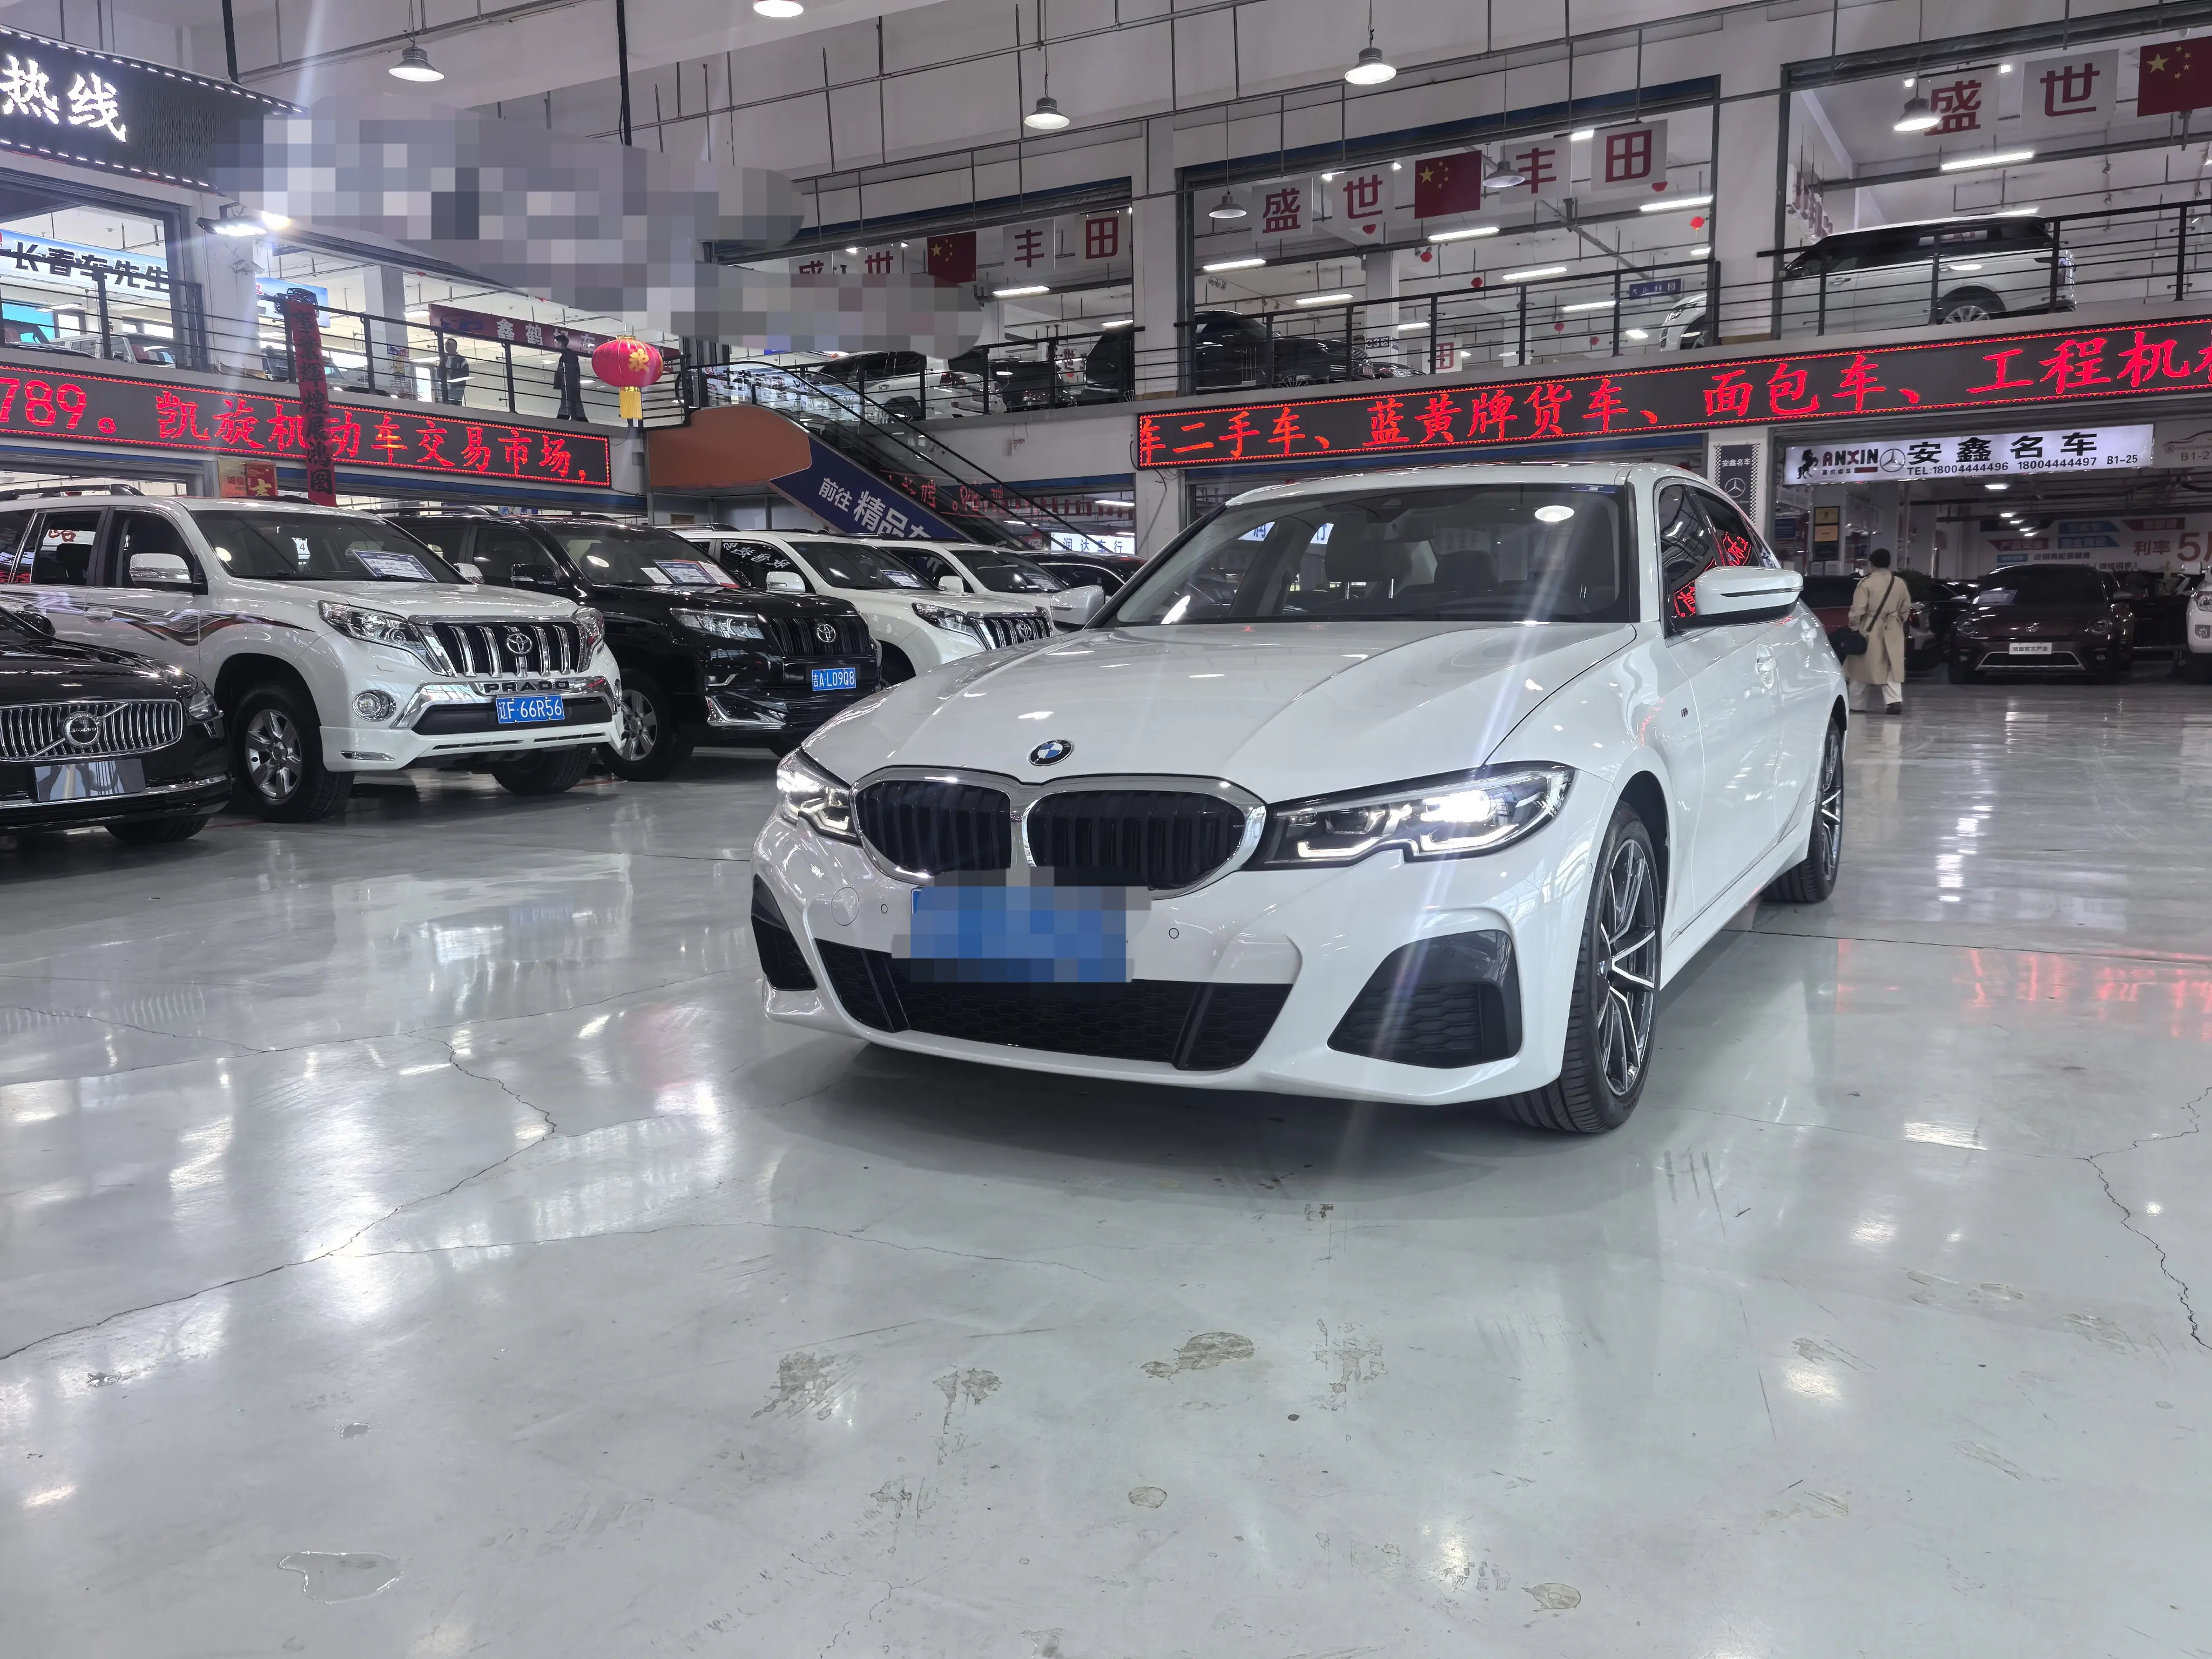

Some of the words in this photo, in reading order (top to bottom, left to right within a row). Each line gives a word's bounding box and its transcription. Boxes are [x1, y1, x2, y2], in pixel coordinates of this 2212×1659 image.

[1, 55, 126, 143] 热线
[1907, 432, 2098, 465] 安鑫名车
[2181, 450, 2212, 461] B1-2
[1822, 449, 1879, 467] ANXIN
[2018, 457, 2097, 470] 18004444497
[2107, 455, 2138, 465] B1-25
[484, 680, 570, 692] PRADO
